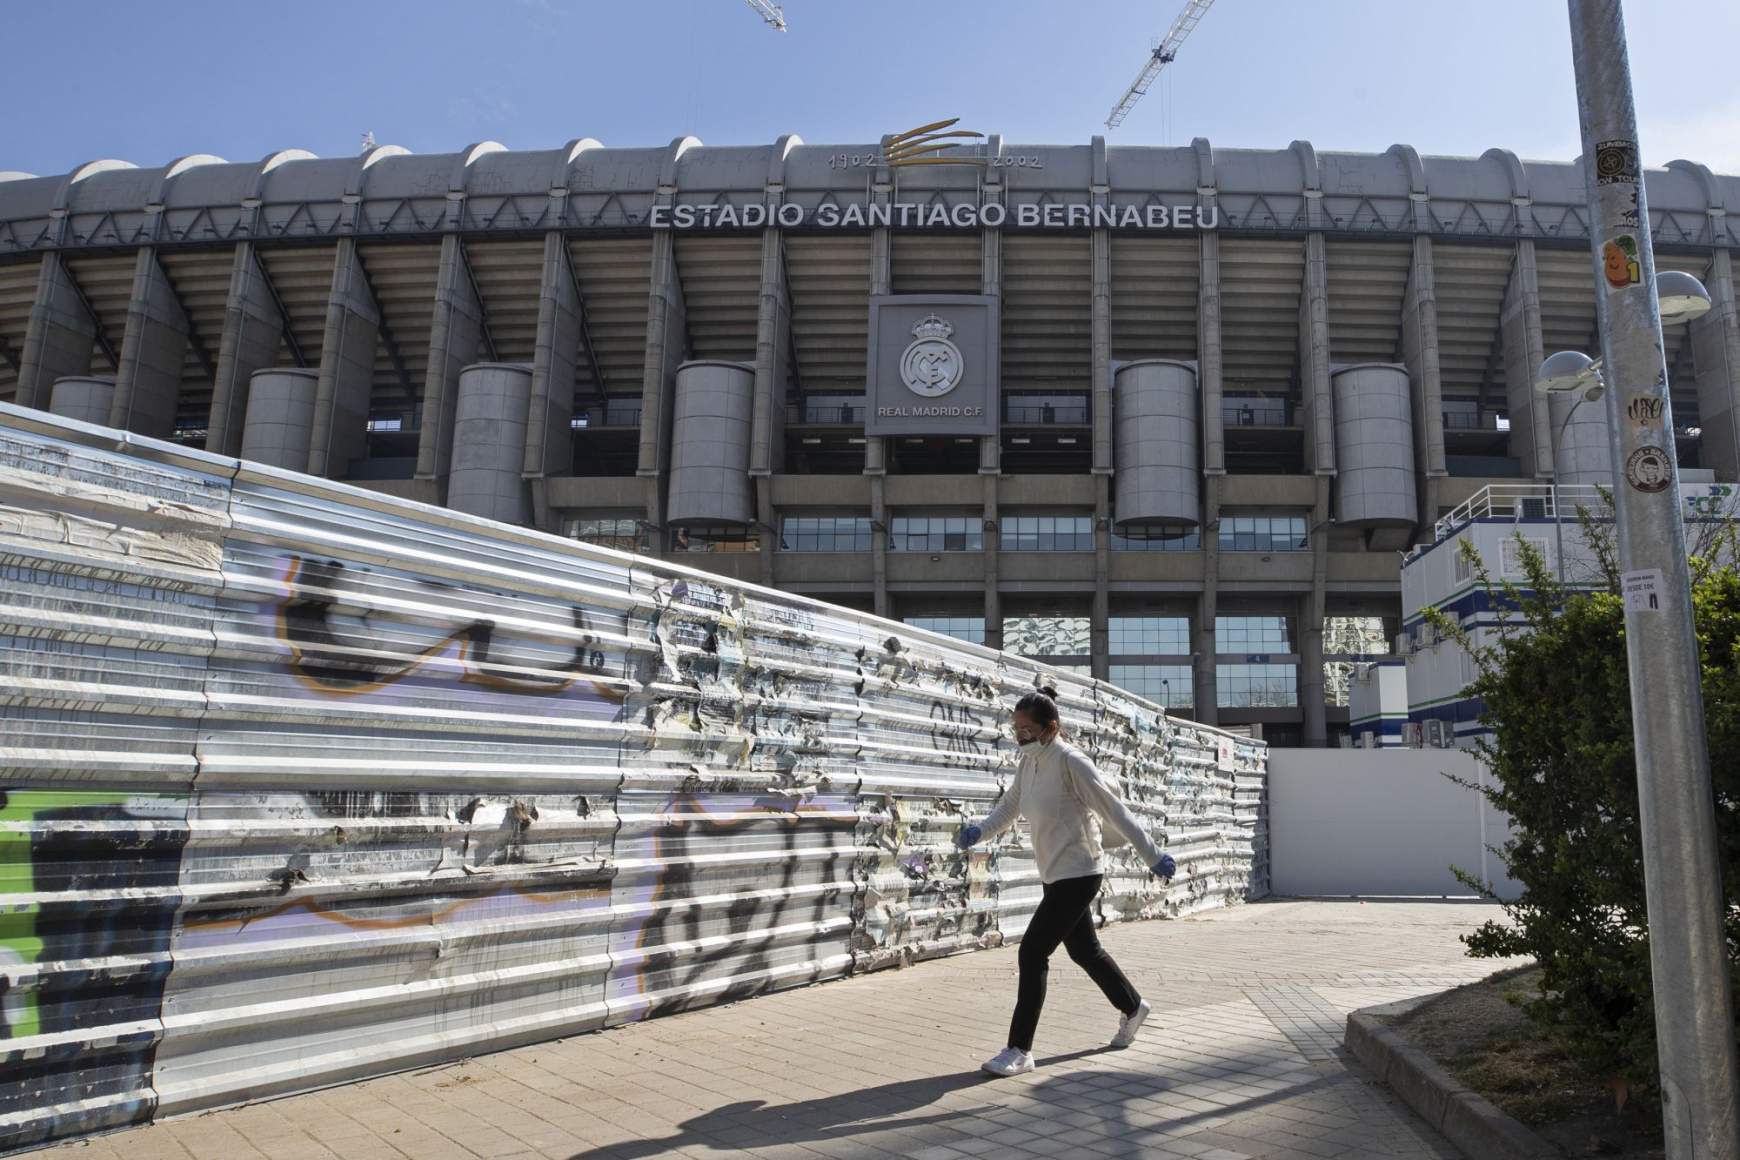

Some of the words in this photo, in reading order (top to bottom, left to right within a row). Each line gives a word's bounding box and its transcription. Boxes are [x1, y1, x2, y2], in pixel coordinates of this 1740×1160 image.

[828, 153, 876, 170] 1902
[993, 155, 1043, 170] 2002
[650, 203, 804, 228] ESTADIO
[817, 202, 1006, 227] SANTIAGO
[1018, 203, 1218, 229] BERNABEU
[878, 407, 909, 417] REAL
[912, 407, 960, 417] MADRID
